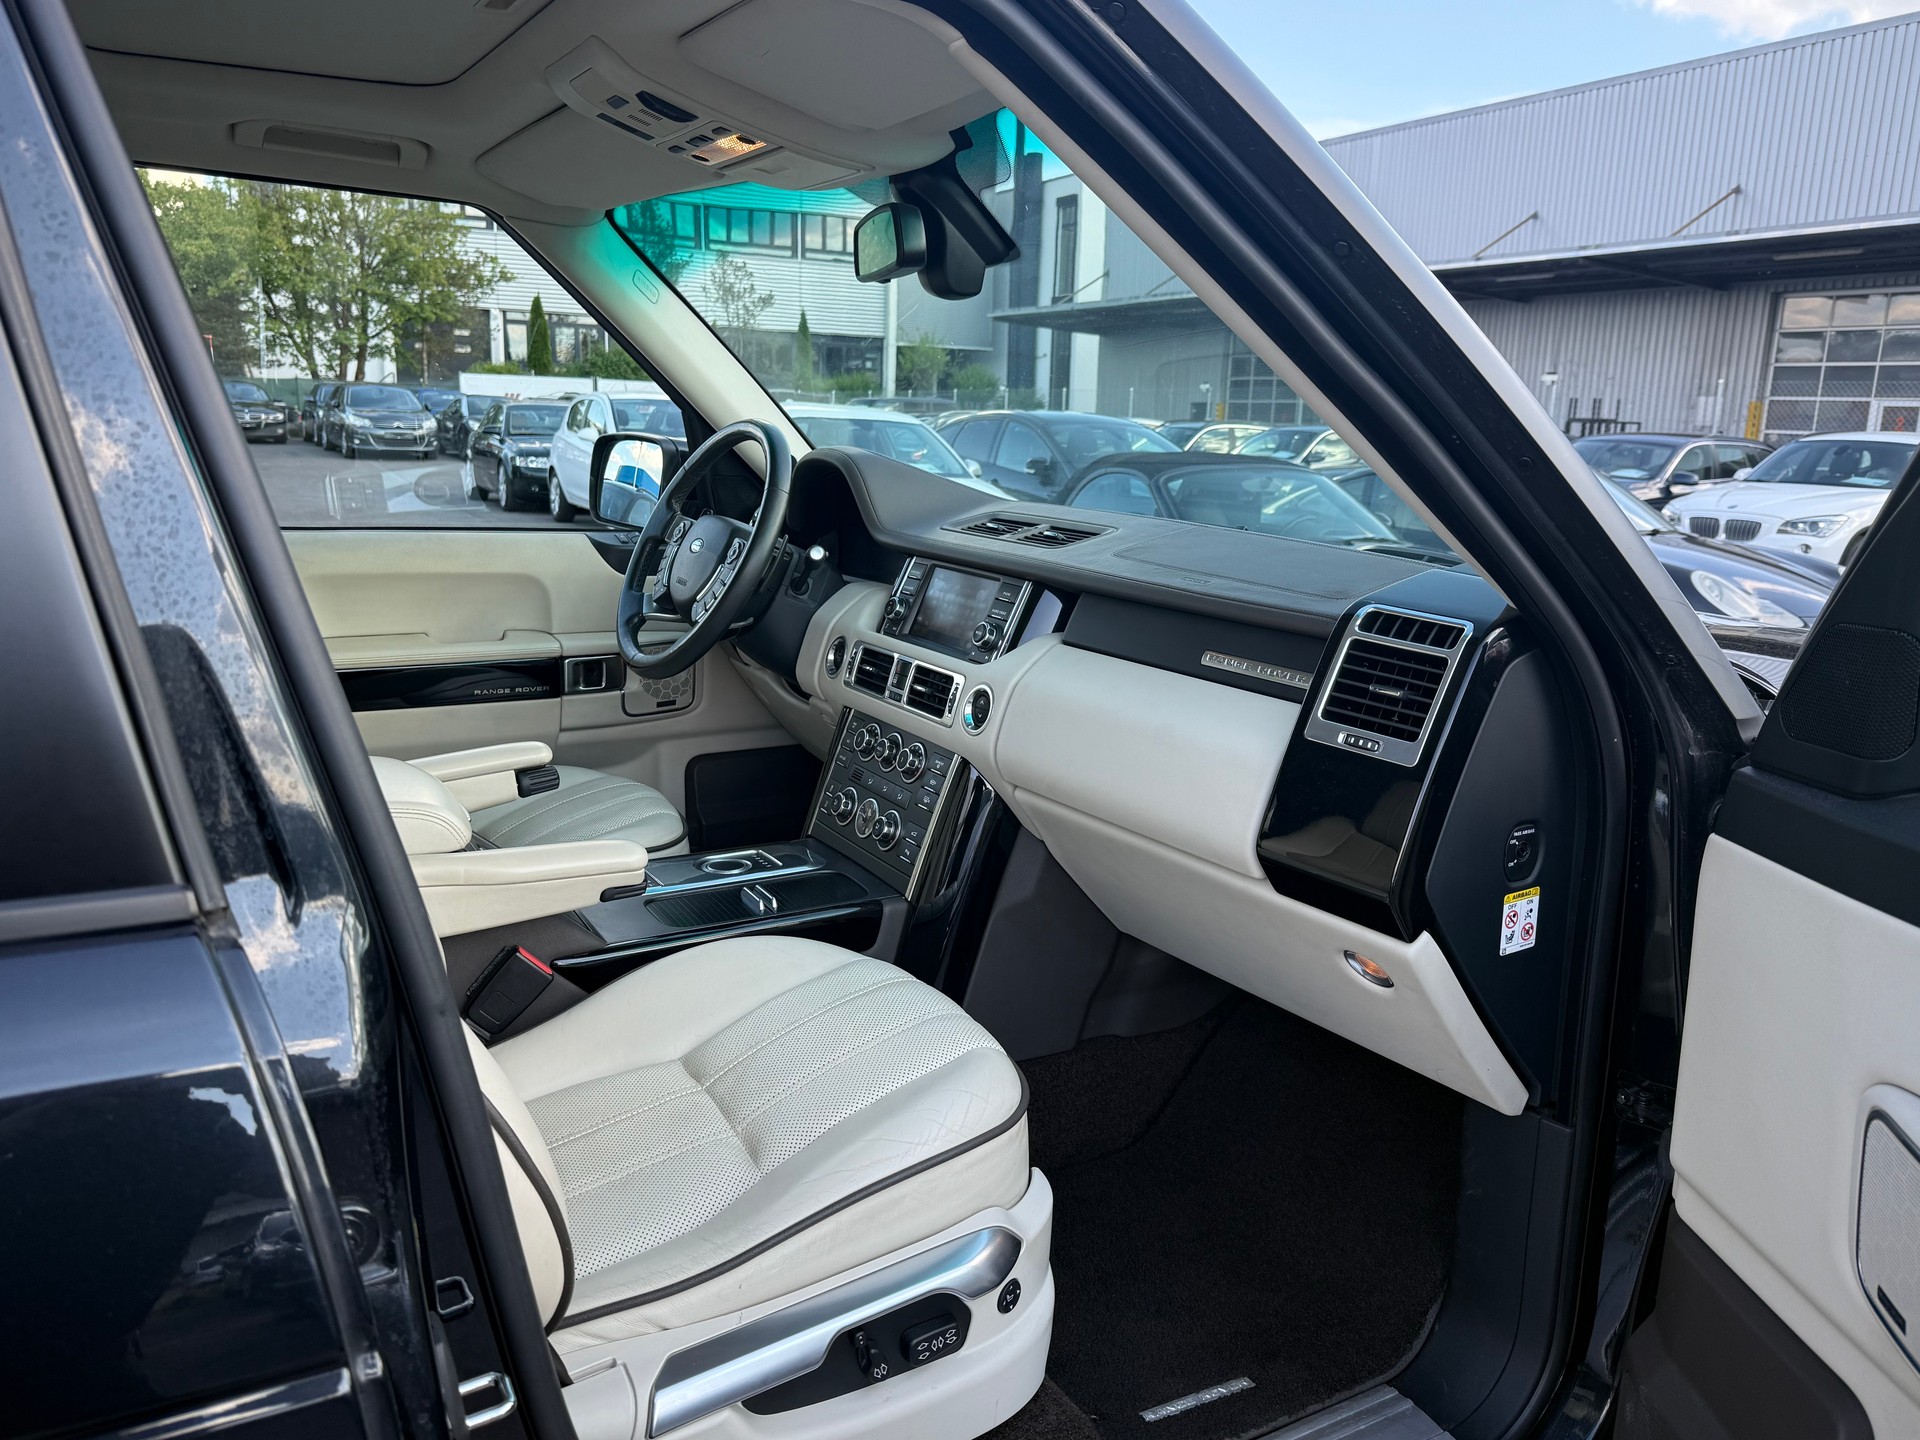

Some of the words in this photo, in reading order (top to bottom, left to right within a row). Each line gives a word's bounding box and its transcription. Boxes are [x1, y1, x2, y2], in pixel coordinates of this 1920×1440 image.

[1206, 653, 1252, 672] RANGE
[1257, 665, 1307, 683] ROVER
[474, 688, 511, 696] RANGE
[515, 685, 550, 693] ROVER
[1512, 890, 1532, 900] AIRBAG
